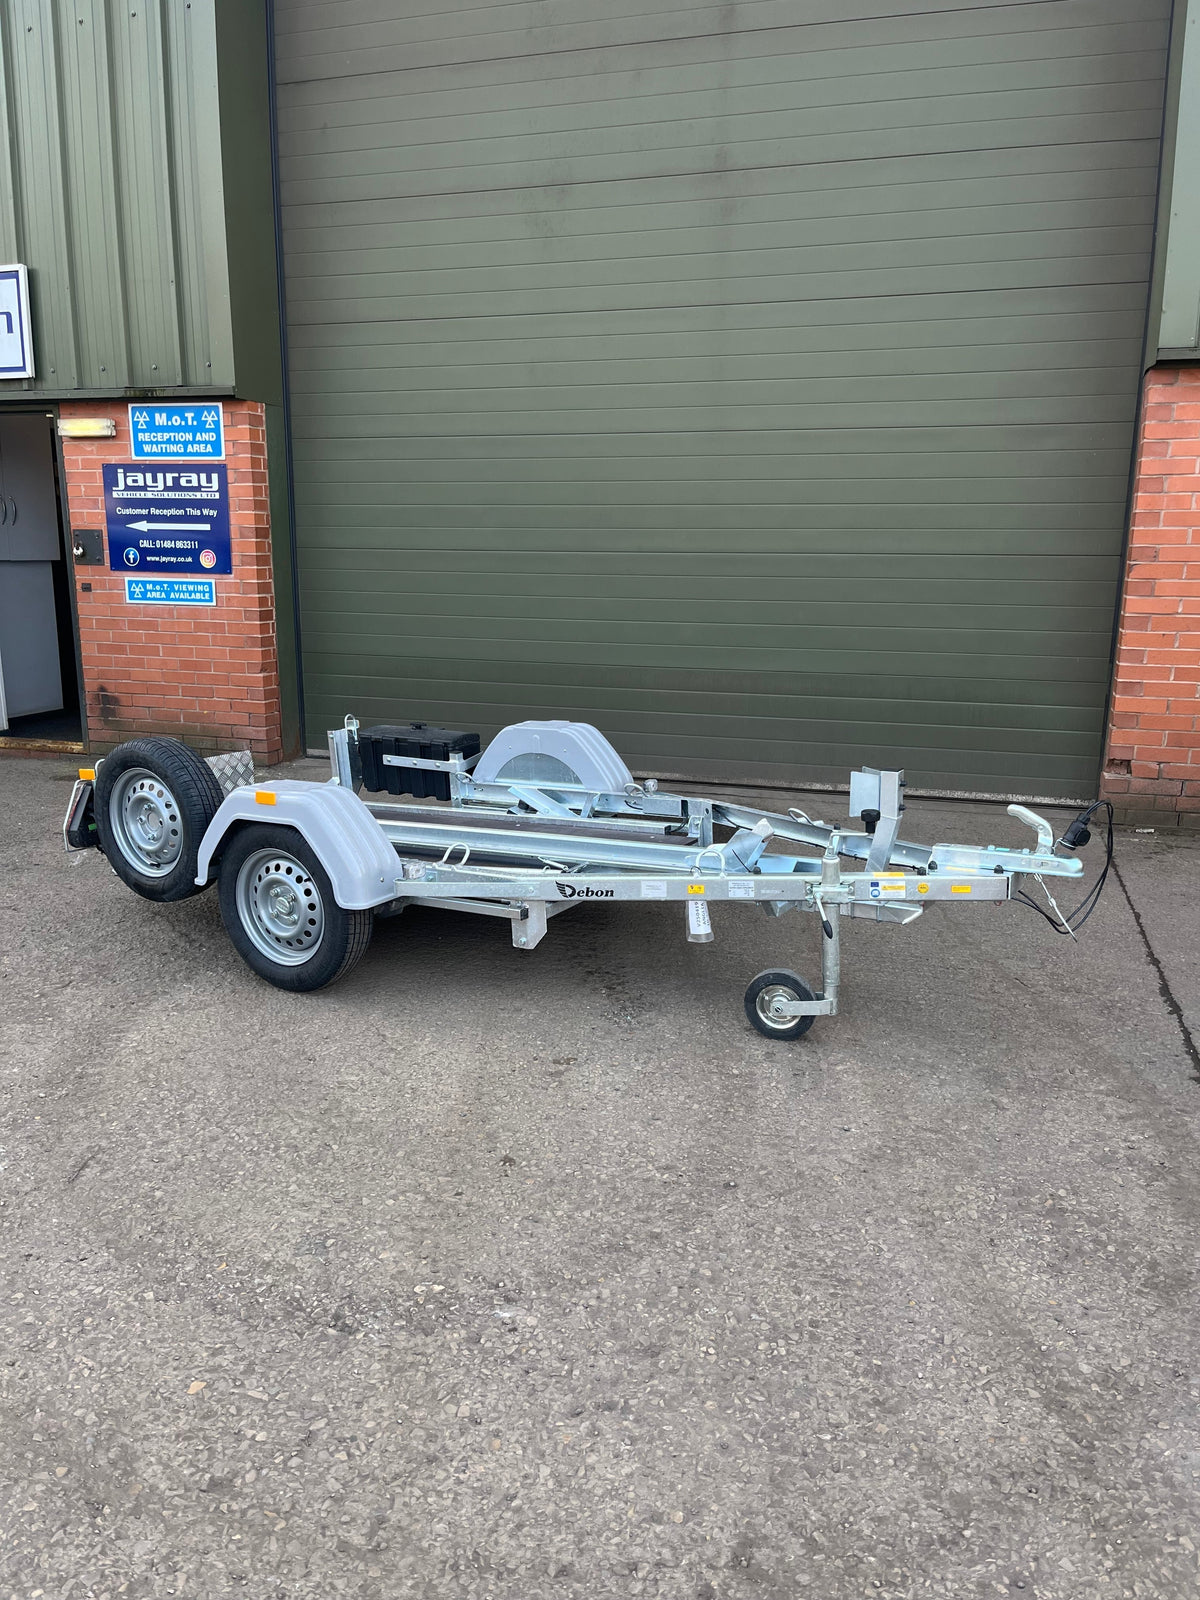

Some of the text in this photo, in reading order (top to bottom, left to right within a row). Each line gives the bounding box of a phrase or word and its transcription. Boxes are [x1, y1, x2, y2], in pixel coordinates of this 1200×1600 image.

[154, 412, 198, 427] M.o.T.
[137, 432, 217, 442] RECEPTION AND
[142, 444, 213, 453] WAITING AREA
[112, 468, 219, 492] jayray
[116, 507, 218, 518] Customer Reception This Way
[139, 540, 198, 549] CALL: 01484 863311
[146, 555, 193, 563] www.jayray.co.uk
[146, 583, 210, 592] M.o.T. VIEWING
[146, 591, 210, 600] AREA AVAILABLE
[555, 880, 615, 899] Debon
